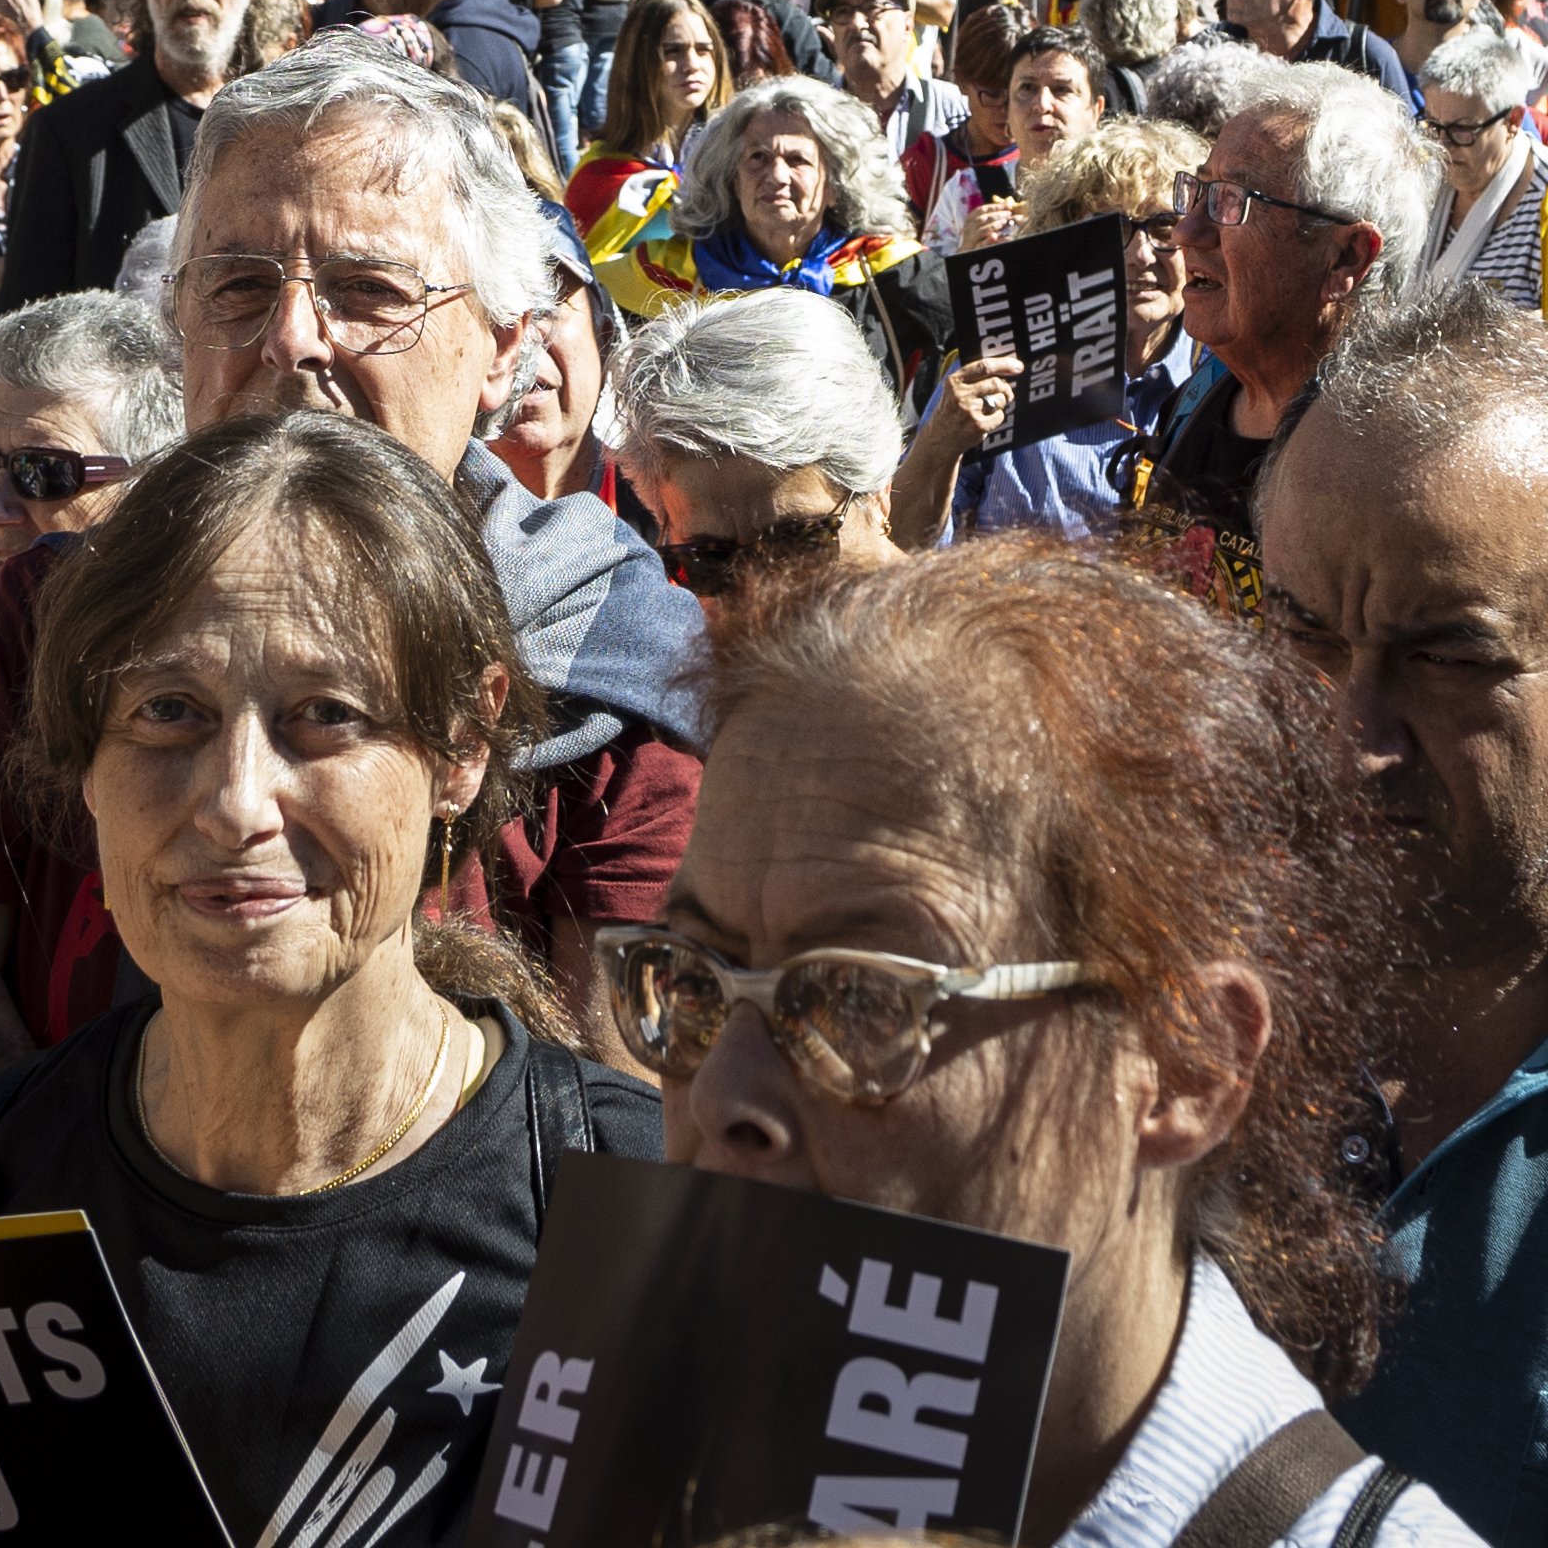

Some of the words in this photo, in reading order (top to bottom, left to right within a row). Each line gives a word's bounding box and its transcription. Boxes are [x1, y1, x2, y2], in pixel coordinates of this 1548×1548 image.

[1024, 292, 1057, 352] HEU
[1059, 268, 1116, 398] TRAÏT
[1029, 354, 1057, 403] ENS
[494, 1348, 595, 1546] ER
